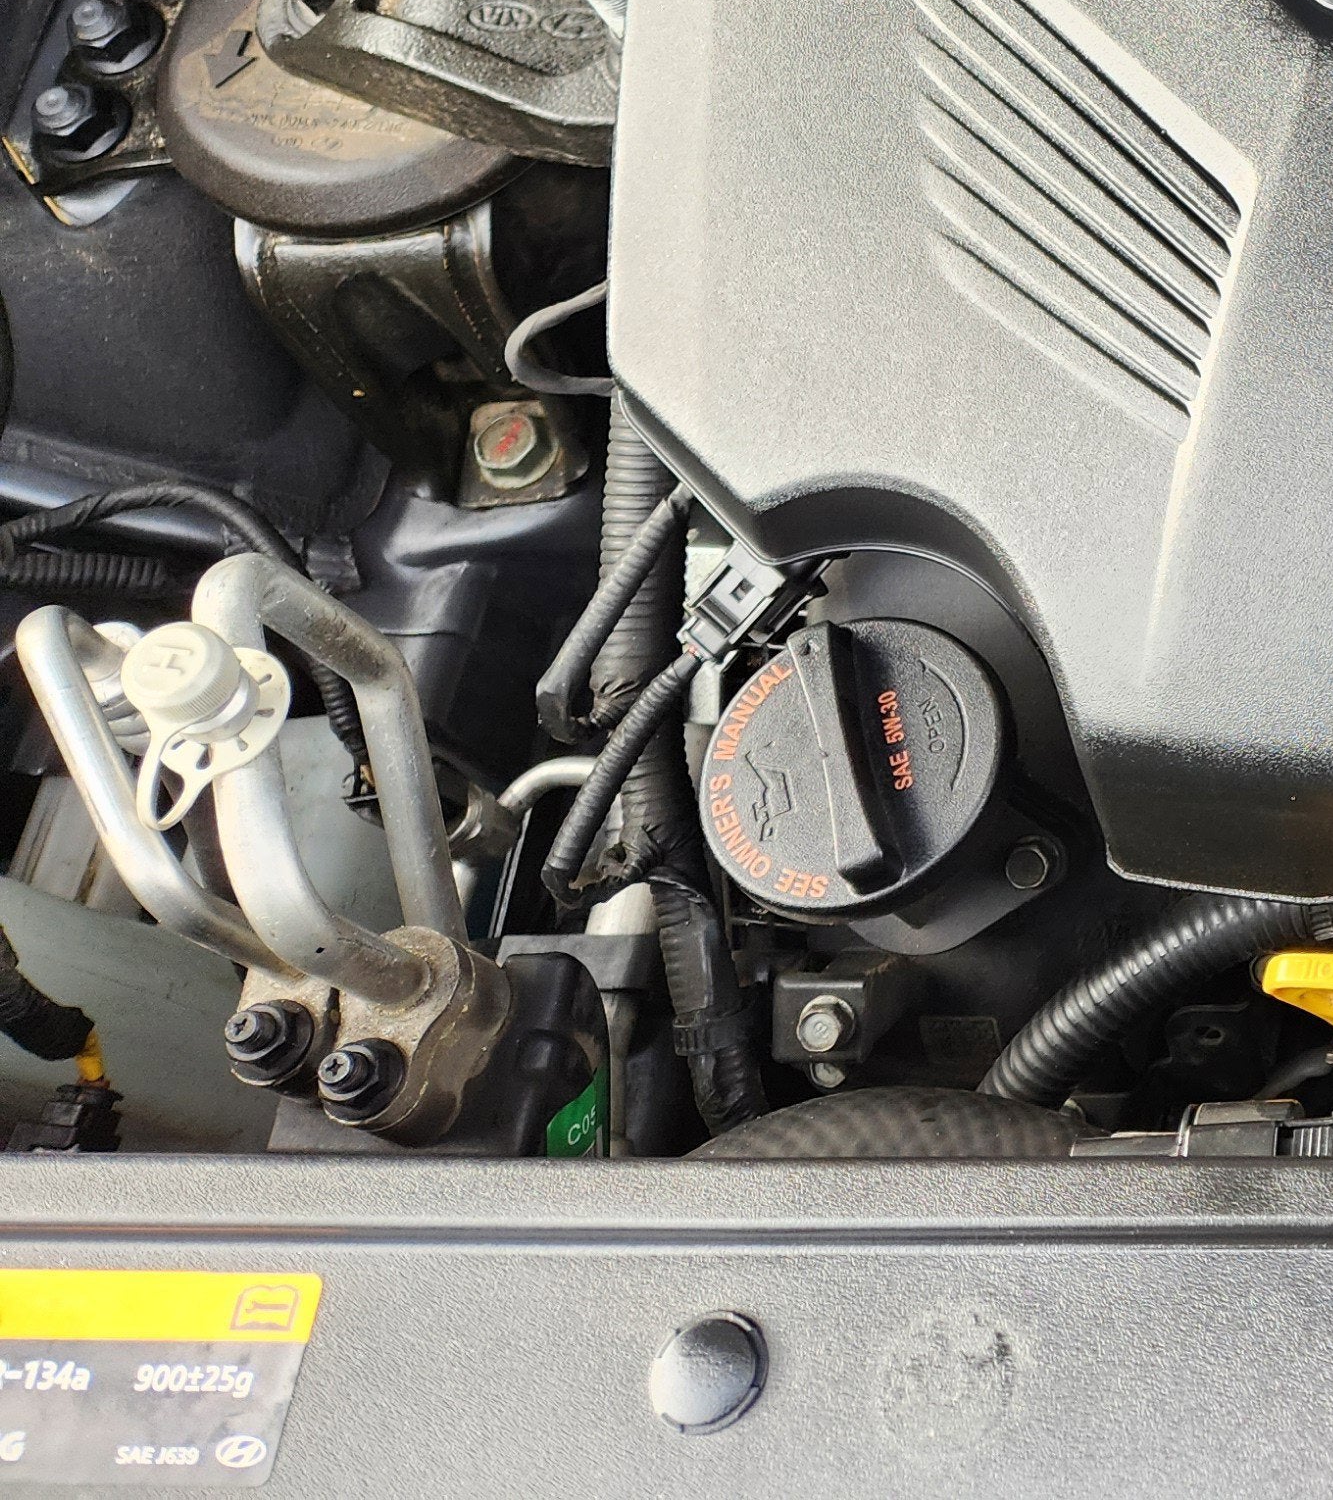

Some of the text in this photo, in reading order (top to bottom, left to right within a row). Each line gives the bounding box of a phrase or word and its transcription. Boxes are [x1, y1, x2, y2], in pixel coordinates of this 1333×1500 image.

[877, 690, 914, 791] SAE 5W-30
[917, 695, 946, 755] OPEN
[711, 662, 831, 899] SEE OWNER'S MANUAL
[134, 1363, 254, 1399] 900±25g
[115, 1445, 153, 1465] SAE
